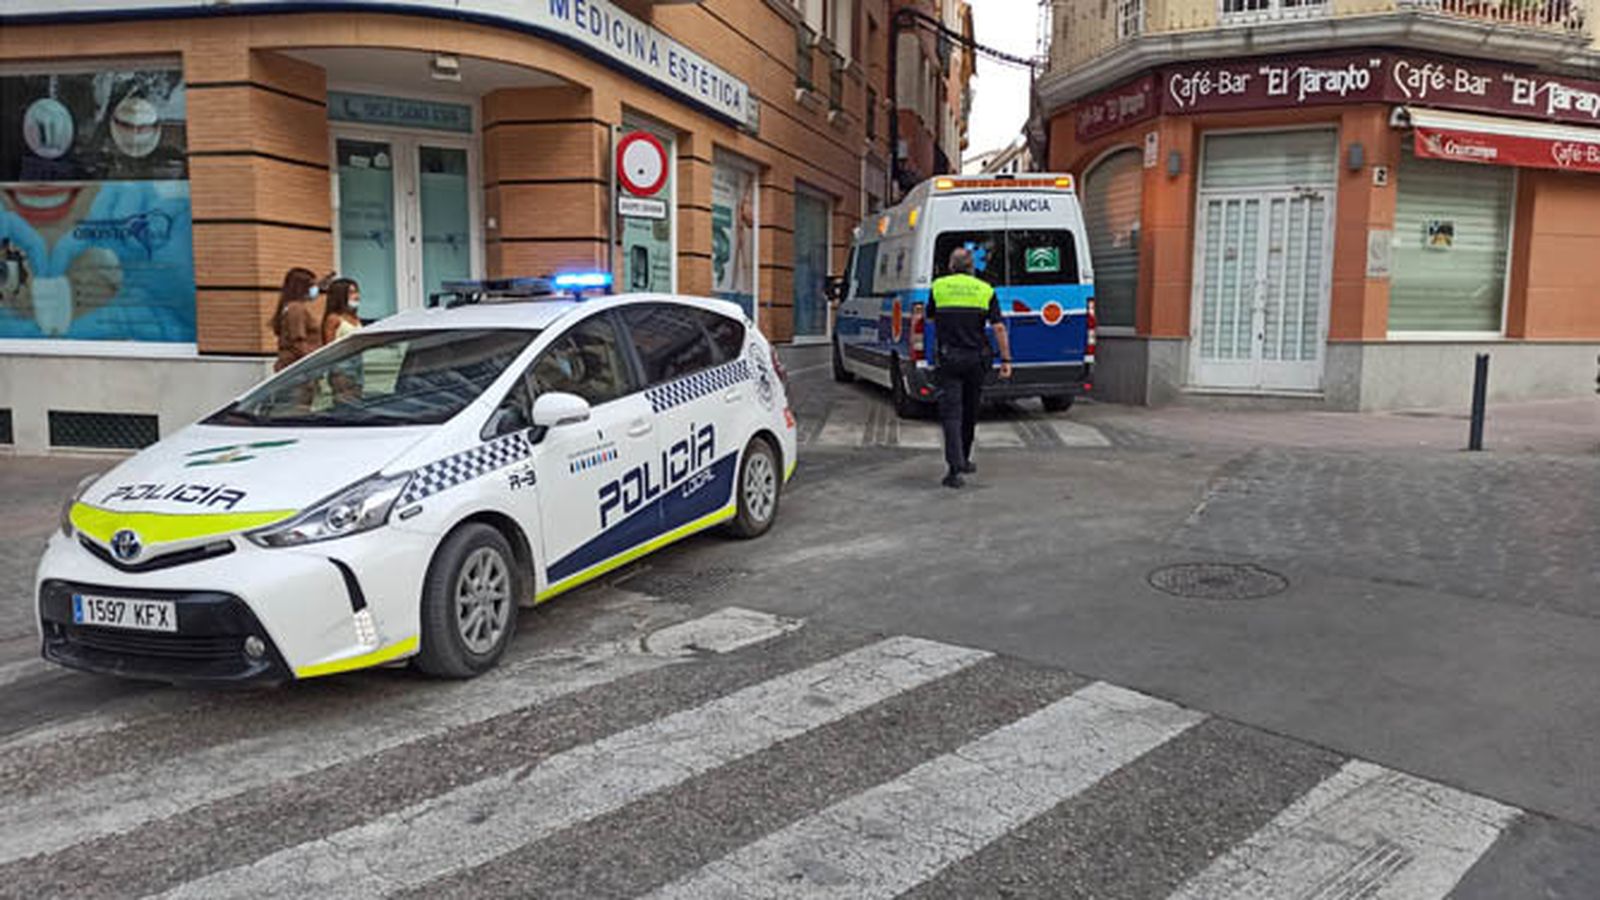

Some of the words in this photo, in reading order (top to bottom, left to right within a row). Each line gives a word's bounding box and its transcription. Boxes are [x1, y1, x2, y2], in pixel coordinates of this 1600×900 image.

[550, 0, 660, 67] MEDICINA
[669, 50, 741, 110] ESTÉTICA
[1169, 70, 1252, 108] Café-Bar
[1393, 60, 1493, 99] Café-Bar
[1535, 81, 1600, 119] Taran
[960, 198, 1052, 213] AMBULANCIA
[681, 468, 716, 499] LOCAL
[88, 600, 126, 624] 1597
[133, 604, 170, 628] KFX
